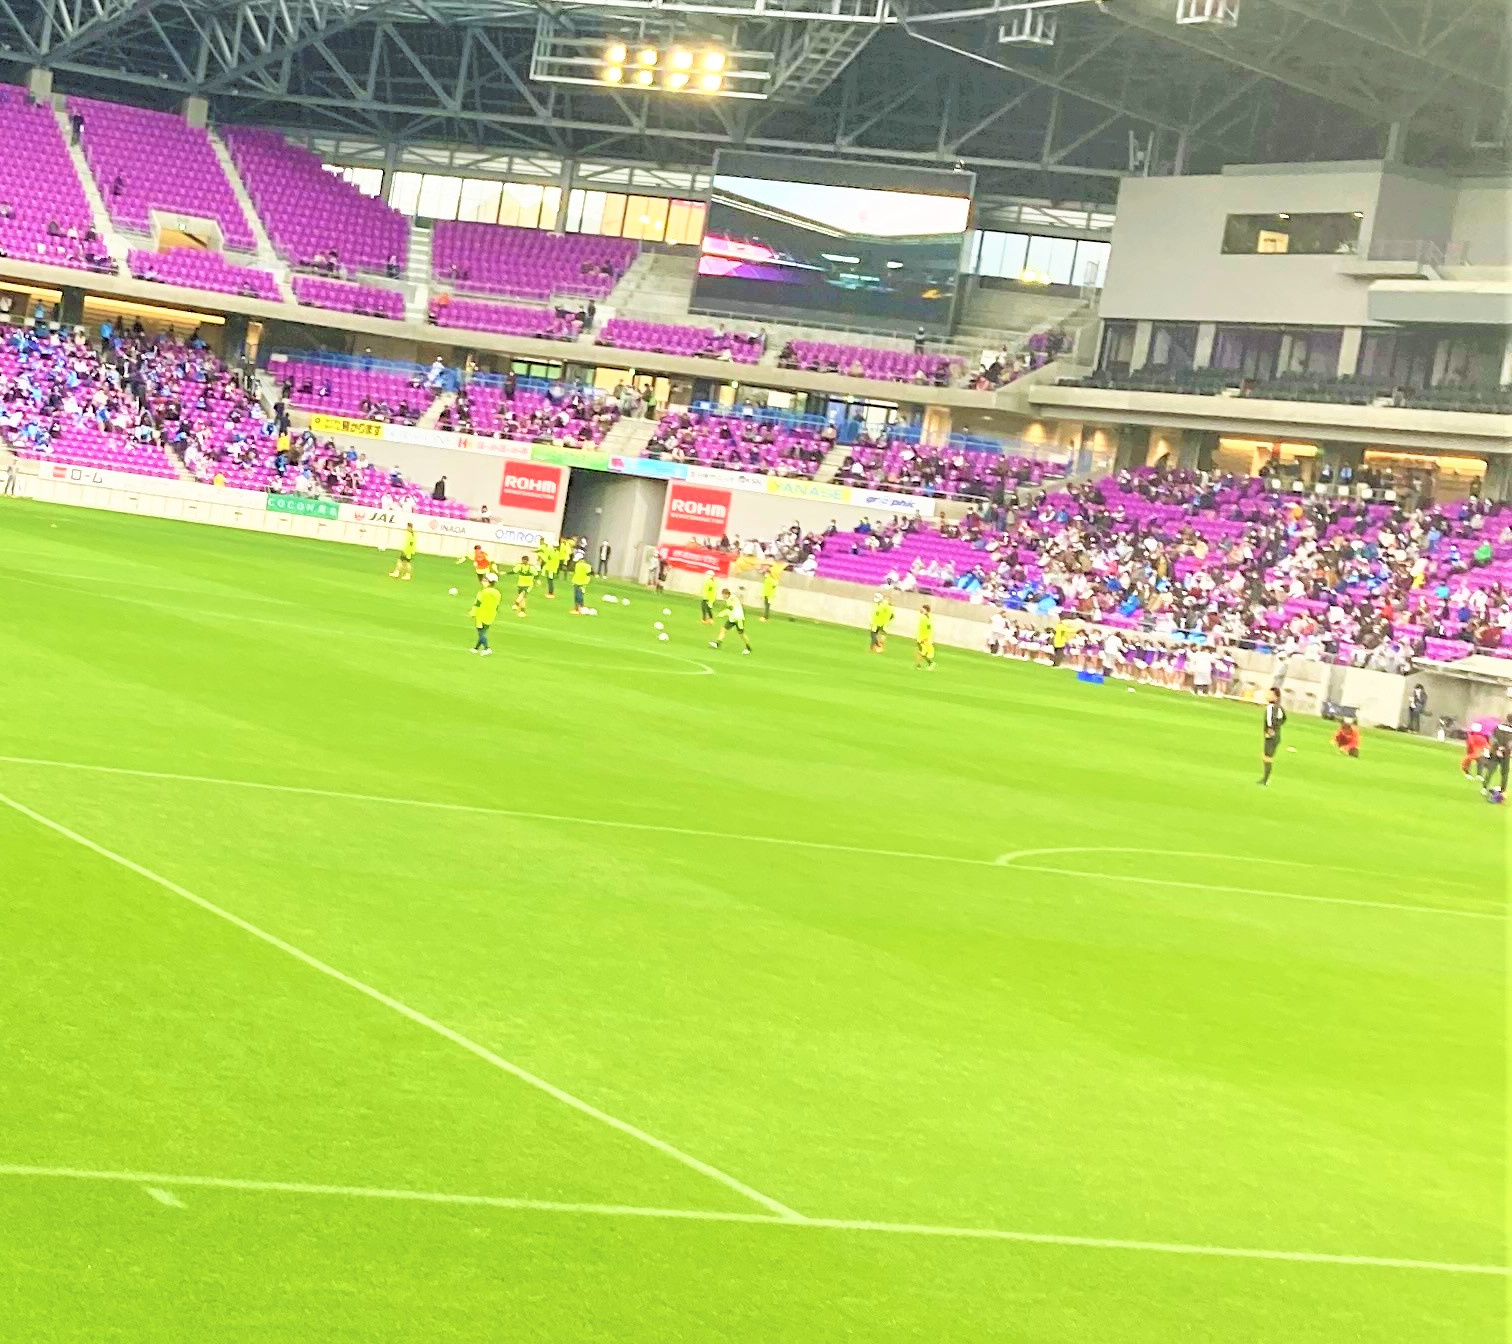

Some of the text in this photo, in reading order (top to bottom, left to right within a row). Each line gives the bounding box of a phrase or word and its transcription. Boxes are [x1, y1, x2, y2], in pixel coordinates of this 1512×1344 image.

[504, 475, 557, 494] ROHM
[774, 482, 843, 501] YANASE
[369, 512, 397, 524] JAL
[671, 499, 727, 518] ROHM
